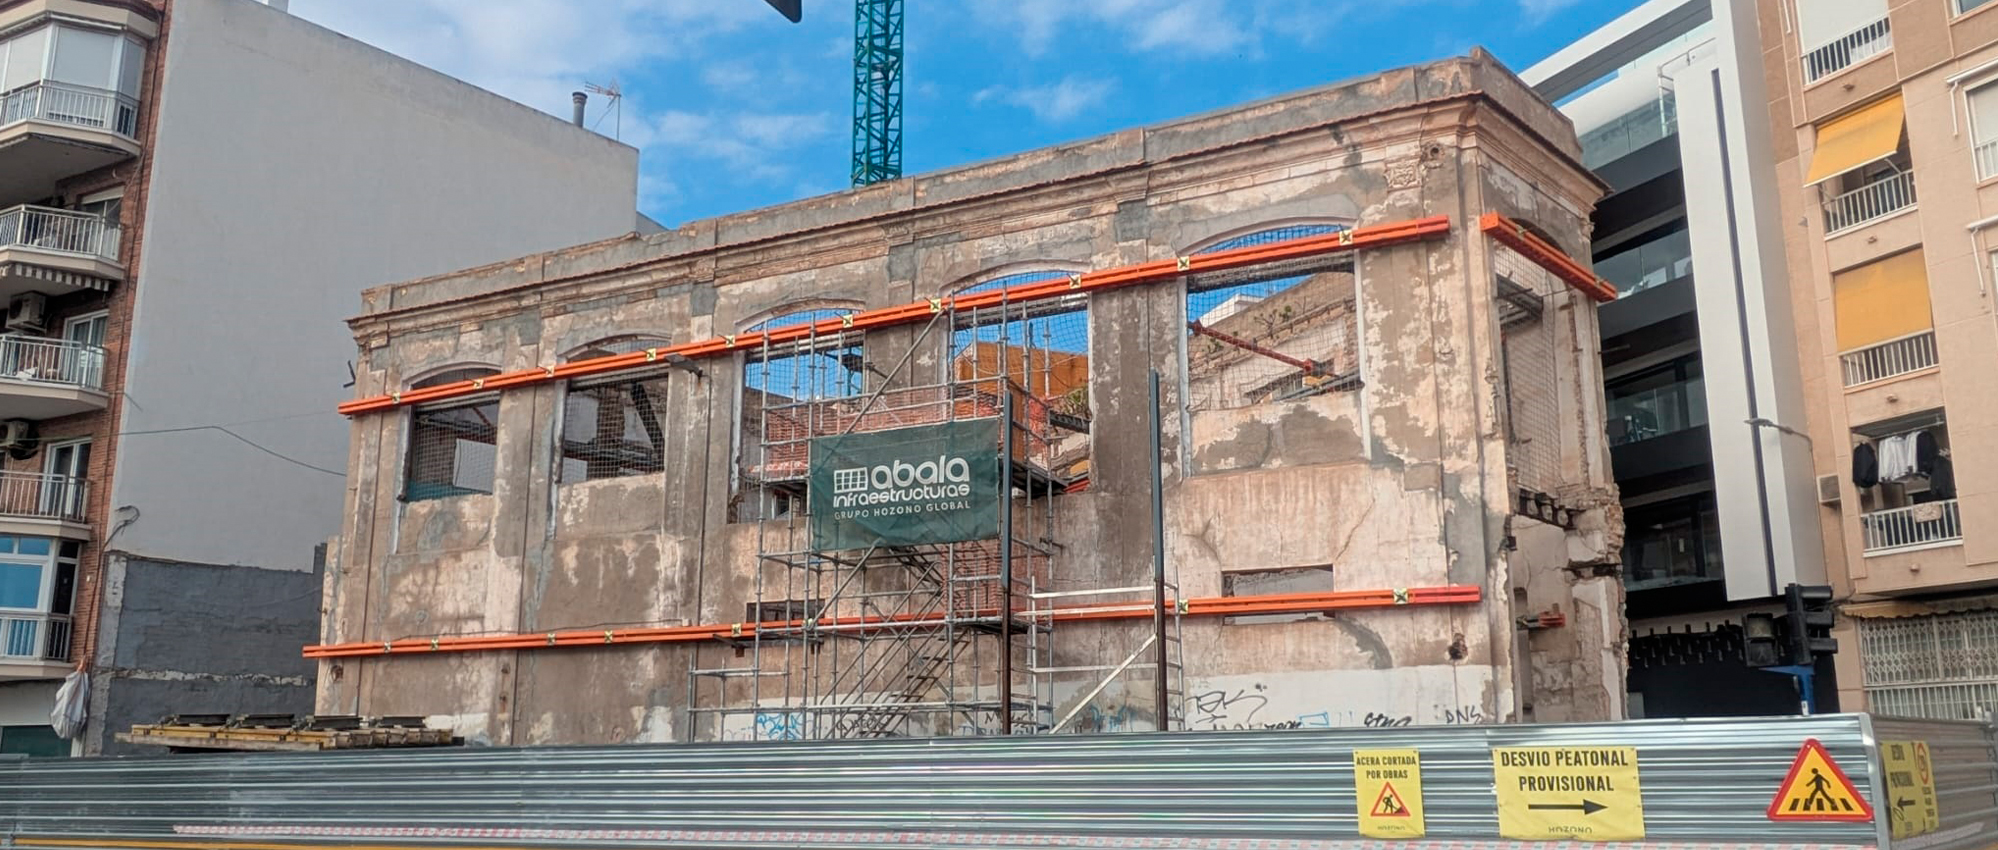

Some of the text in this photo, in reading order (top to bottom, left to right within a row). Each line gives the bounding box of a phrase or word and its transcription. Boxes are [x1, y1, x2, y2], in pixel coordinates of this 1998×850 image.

[870, 455, 970, 489] abala
[833, 483, 970, 508] infraestructuras
[834, 501, 971, 520] GRUPO HOZONO GLOBAL
[1356, 756, 1417, 766] ACERA CORTADA
[1501, 750, 1629, 767] DESVIO PEATONAL
[1366, 770, 1408, 779] POR OBRAS
[1518, 775, 1615, 791] PROVISIONAL
